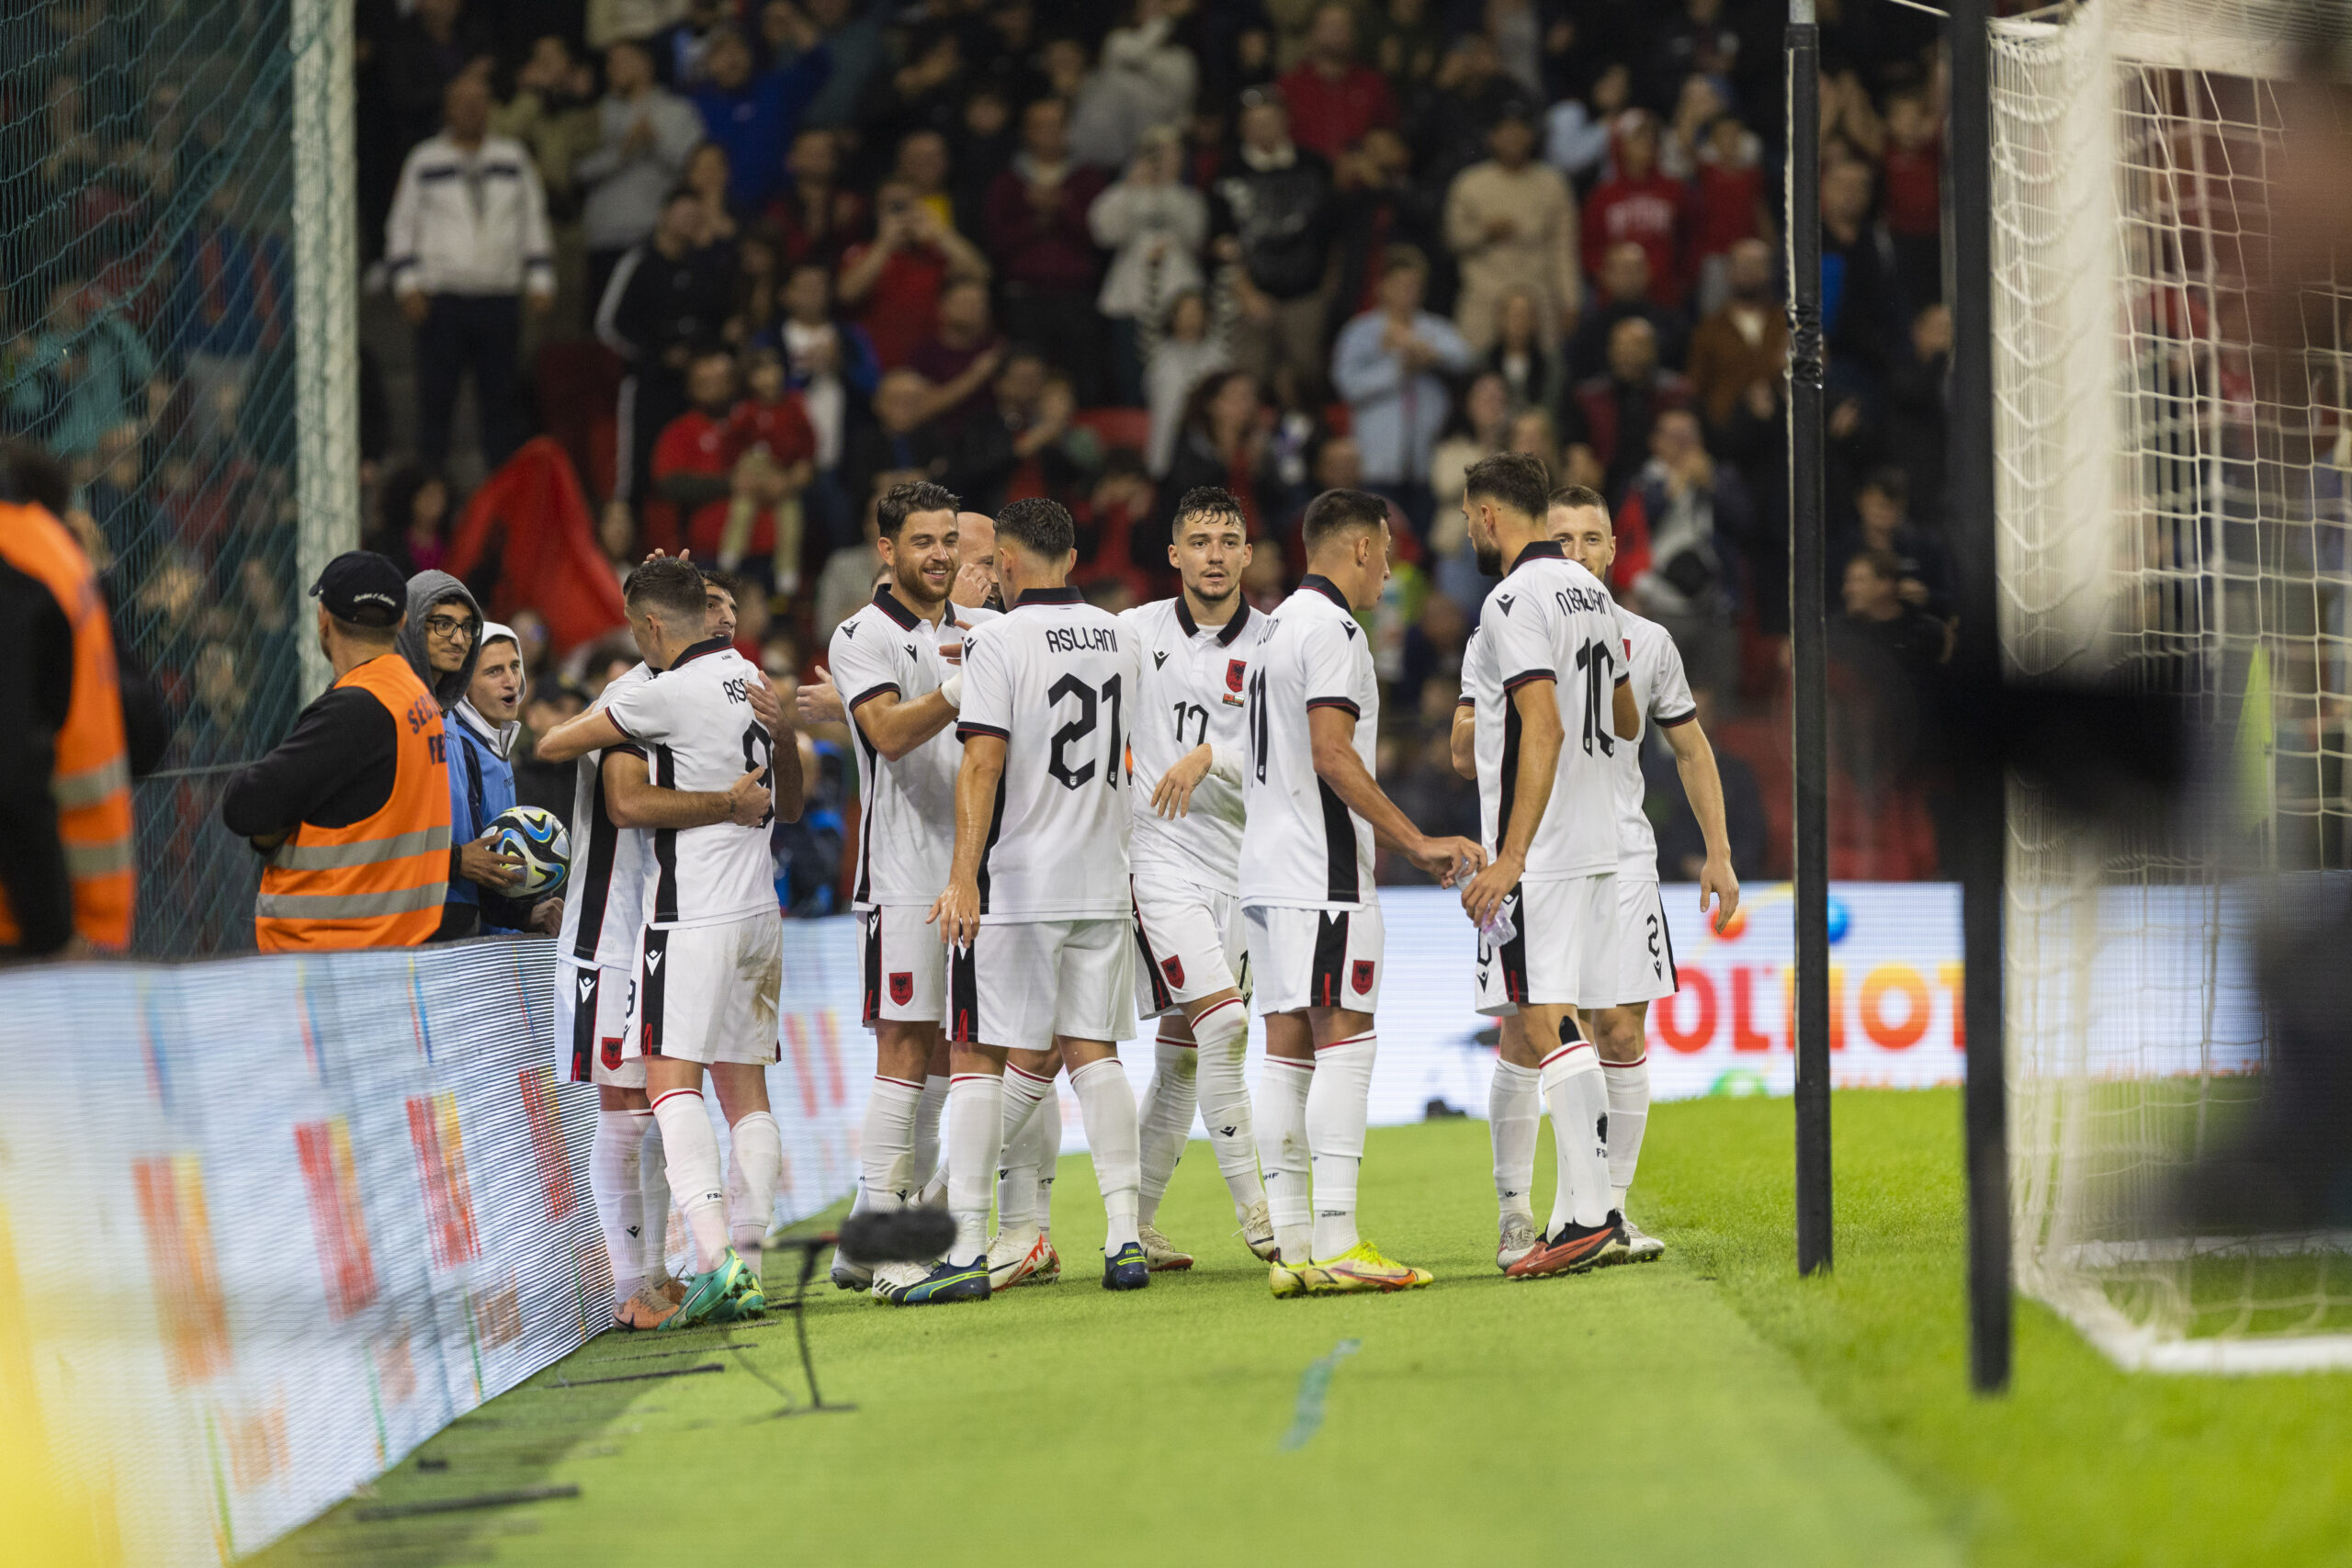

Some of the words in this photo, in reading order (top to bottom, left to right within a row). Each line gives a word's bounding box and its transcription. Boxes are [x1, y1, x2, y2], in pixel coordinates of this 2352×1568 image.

[1046, 626, 1118, 653] ASLLANI
[1047, 672, 1122, 791] 21
[1173, 701, 1209, 747] 17
[1249, 665, 1268, 788] 11
[1576, 636, 1614, 758] 10
[742, 719, 775, 829] 9
[1647, 913, 1659, 958] 2
